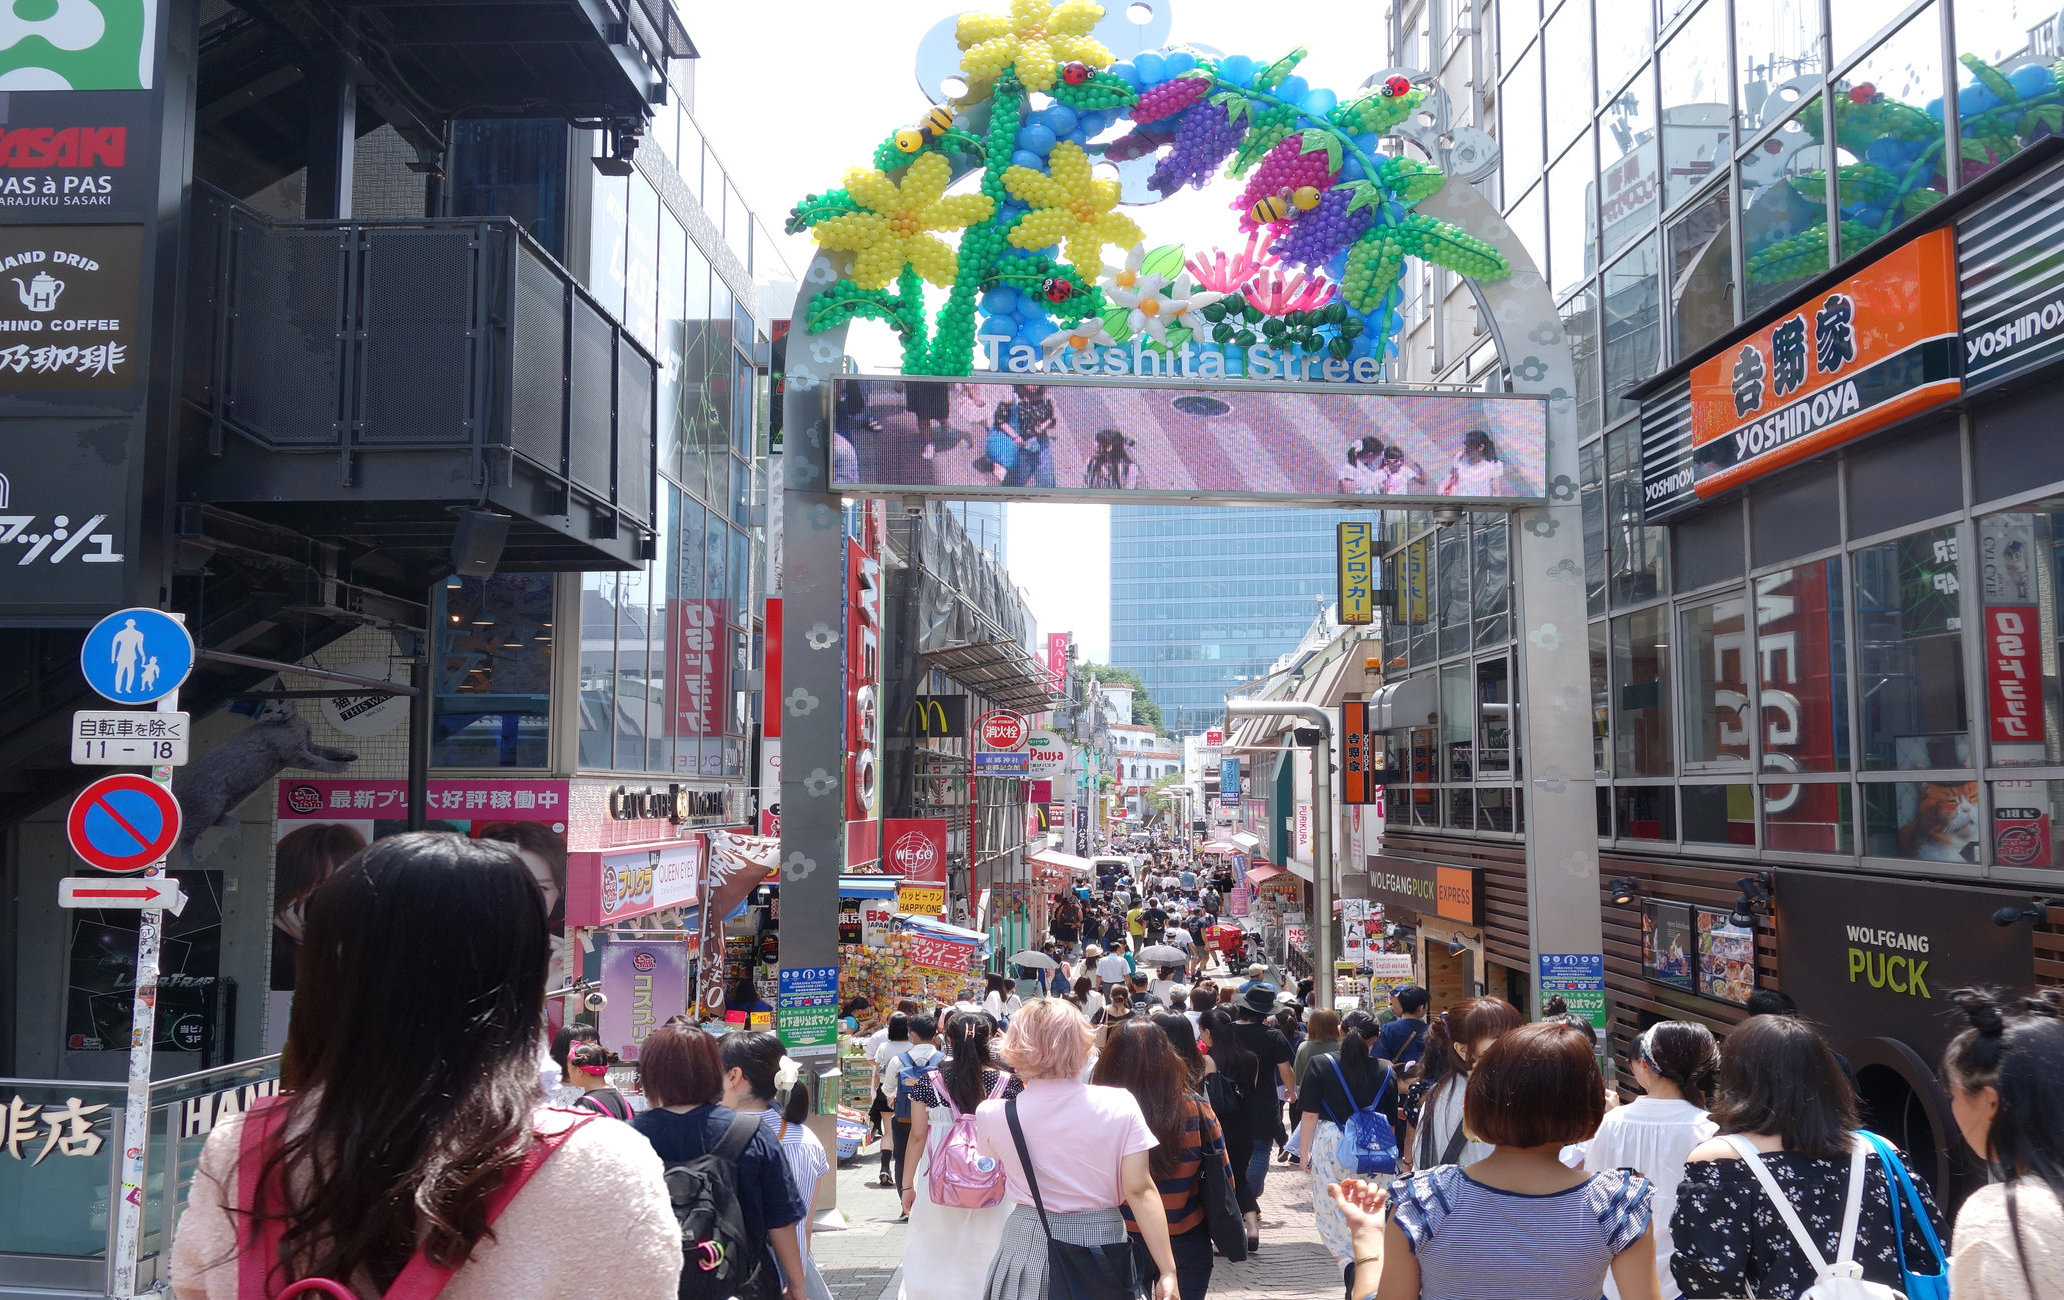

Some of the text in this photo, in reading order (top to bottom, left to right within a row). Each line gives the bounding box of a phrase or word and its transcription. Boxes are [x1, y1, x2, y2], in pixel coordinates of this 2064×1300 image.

[0, 127, 127, 168] ASAKI
[42, 176, 56, 194] à
[64, 176, 112, 194] PAS
[63, 196, 111, 206] SASAKI
[53, 251, 100, 271] DRIP
[50, 319, 120, 331] COFFEE
[978, 334, 1398, 384] Takeshita Street
[1731, 293, 1857, 419] 吉野家
[1735, 380, 1860, 461] YOSHINOYA
[1345, 525, 1368, 611] コインロッカー
[80, 719, 181, 737] 自転車を除く
[985, 725, 1018, 738] 消火栓
[153, 741, 173, 759] 18
[1030, 748, 1064, 762] Pausa
[1299, 805, 1308, 845] PURIKURA
[895, 849, 933, 861] WE GO
[618, 864, 653, 899] プリクラ
[659, 860, 694, 884] QUEEN EYES
[900, 891, 942, 901] ハッピーワン
[1370, 870, 1470, 905] WOLFGANG PUCK EXPRESS
[866, 909, 890, 922] 日本
[899, 904, 941, 913] HAPPY ONE
[838, 913, 861, 924] 東京
[1846, 924, 1930, 953] WOLFGANG
[911, 944, 972, 966] スクイーズ
[1847, 948, 1931, 1000] PUCK
[780, 1014, 836, 1028] 竹下通り公式マップ
